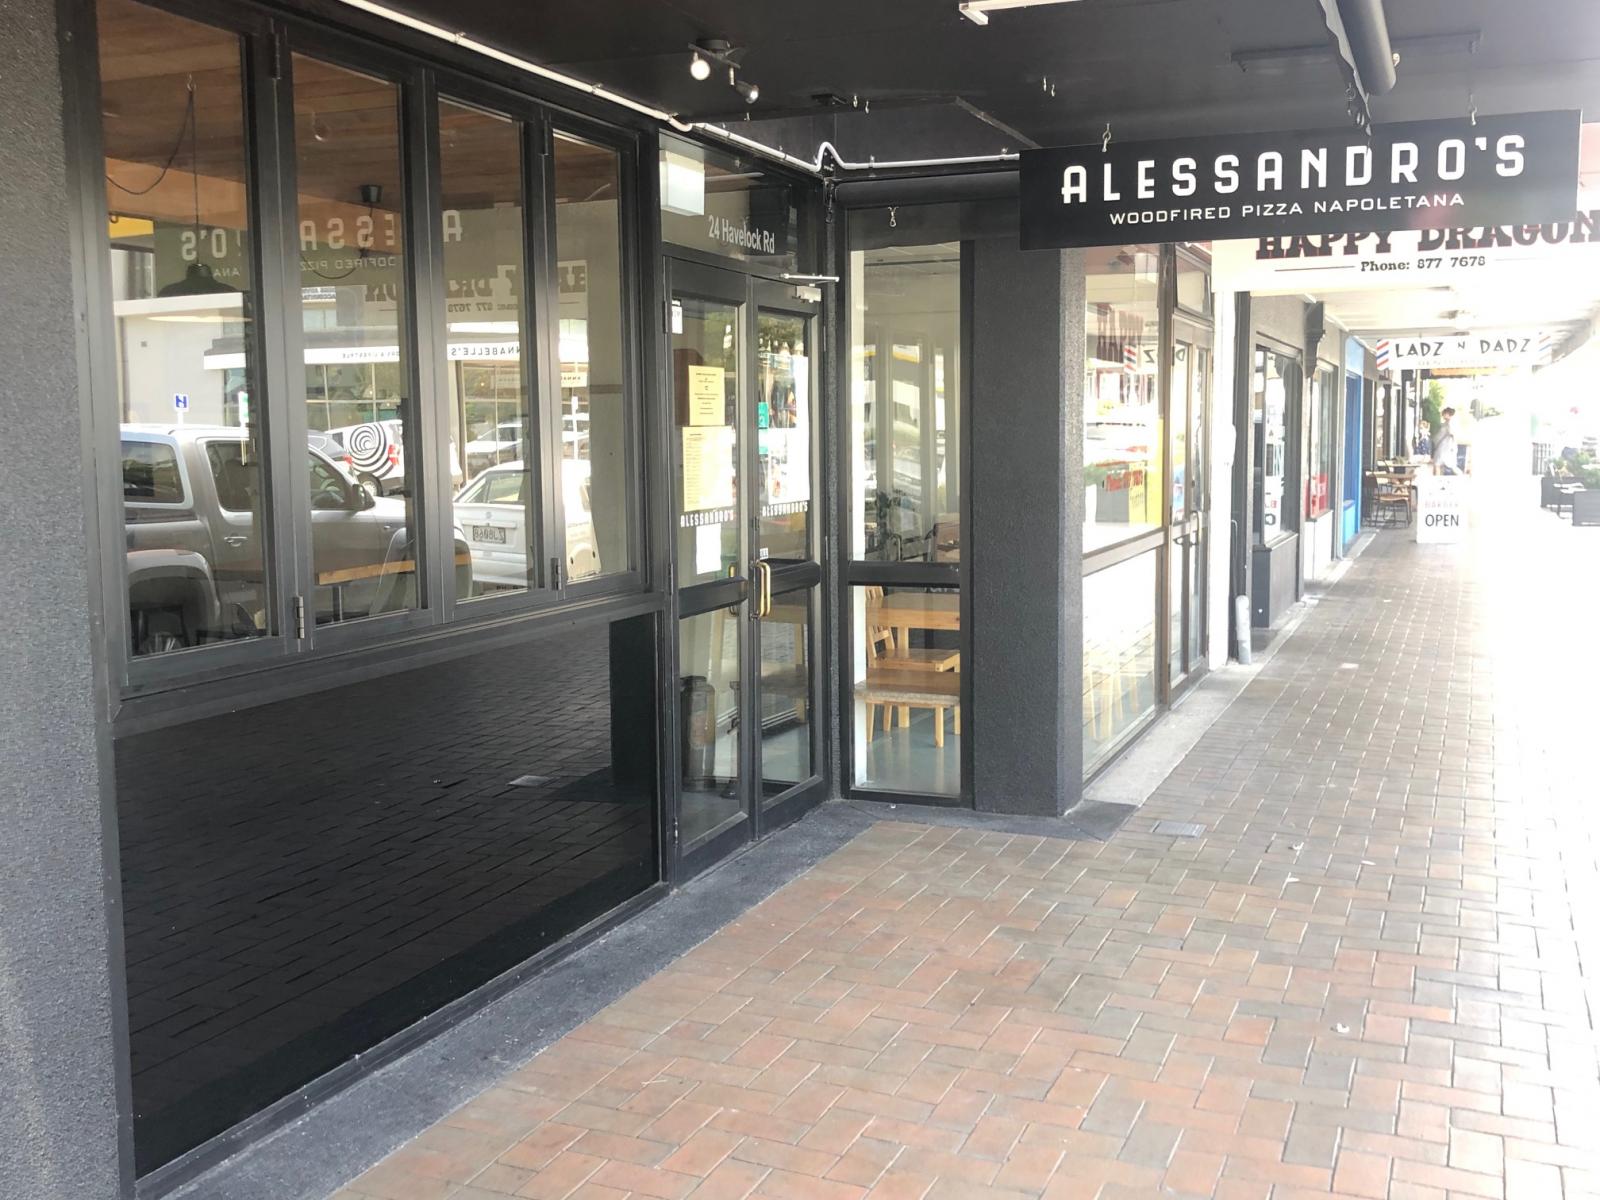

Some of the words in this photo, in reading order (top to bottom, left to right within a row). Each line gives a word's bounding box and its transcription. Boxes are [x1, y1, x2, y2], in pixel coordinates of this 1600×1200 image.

[1061, 134, 1525, 204] ALESSANDRO'S
[1109, 206, 1231, 226] WOODFIRED
[1242, 202, 1303, 219] PIZZA
[1313, 192, 1466, 214] NAPOLETANA
[708, 214, 720, 240] 24
[722, 217, 762, 251] Havelock
[763, 230, 775, 254] Rd
[1361, 258, 1410, 272] Phone:
[1417, 257, 1442, 269] 877
[1451, 255, 1486, 268] 7678
[1395, 342, 1444, 358] LADZ
[1479, 338, 1531, 354] DADZ
[1425, 513, 1459, 527] OPEN
